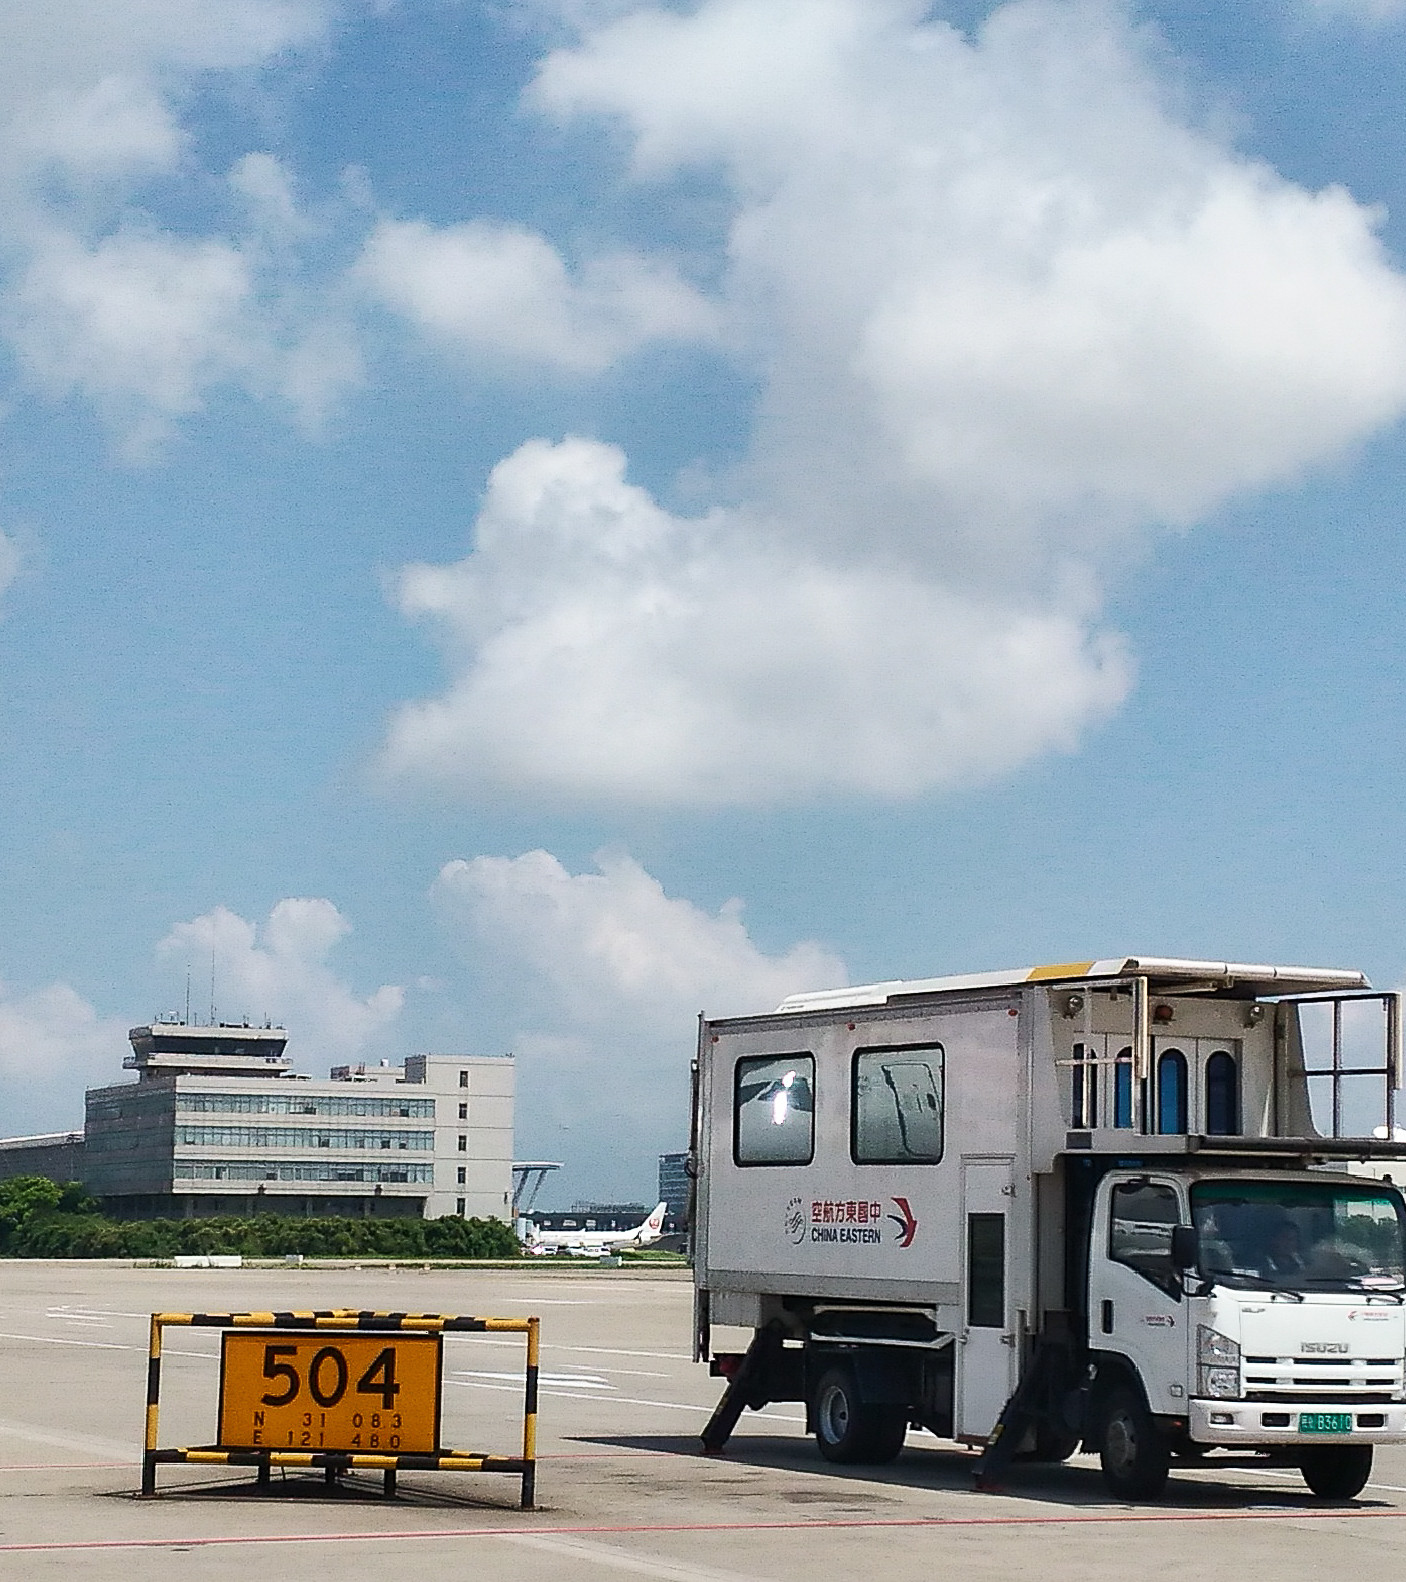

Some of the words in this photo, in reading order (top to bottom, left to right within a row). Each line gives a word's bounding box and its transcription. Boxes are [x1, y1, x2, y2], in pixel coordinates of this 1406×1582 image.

[811, 1228, 838, 1242] CHINA
[840, 1228, 881, 1243] EASTERN
[1301, 1342, 1349, 1354] ISUZU
[261, 1345, 400, 1410] 504
[253, 1411, 265, 1426] N
[302, 1412, 326, 1428] 31
[253, 1430, 263, 1445] E
[288, 1430, 324, 1447] 121
